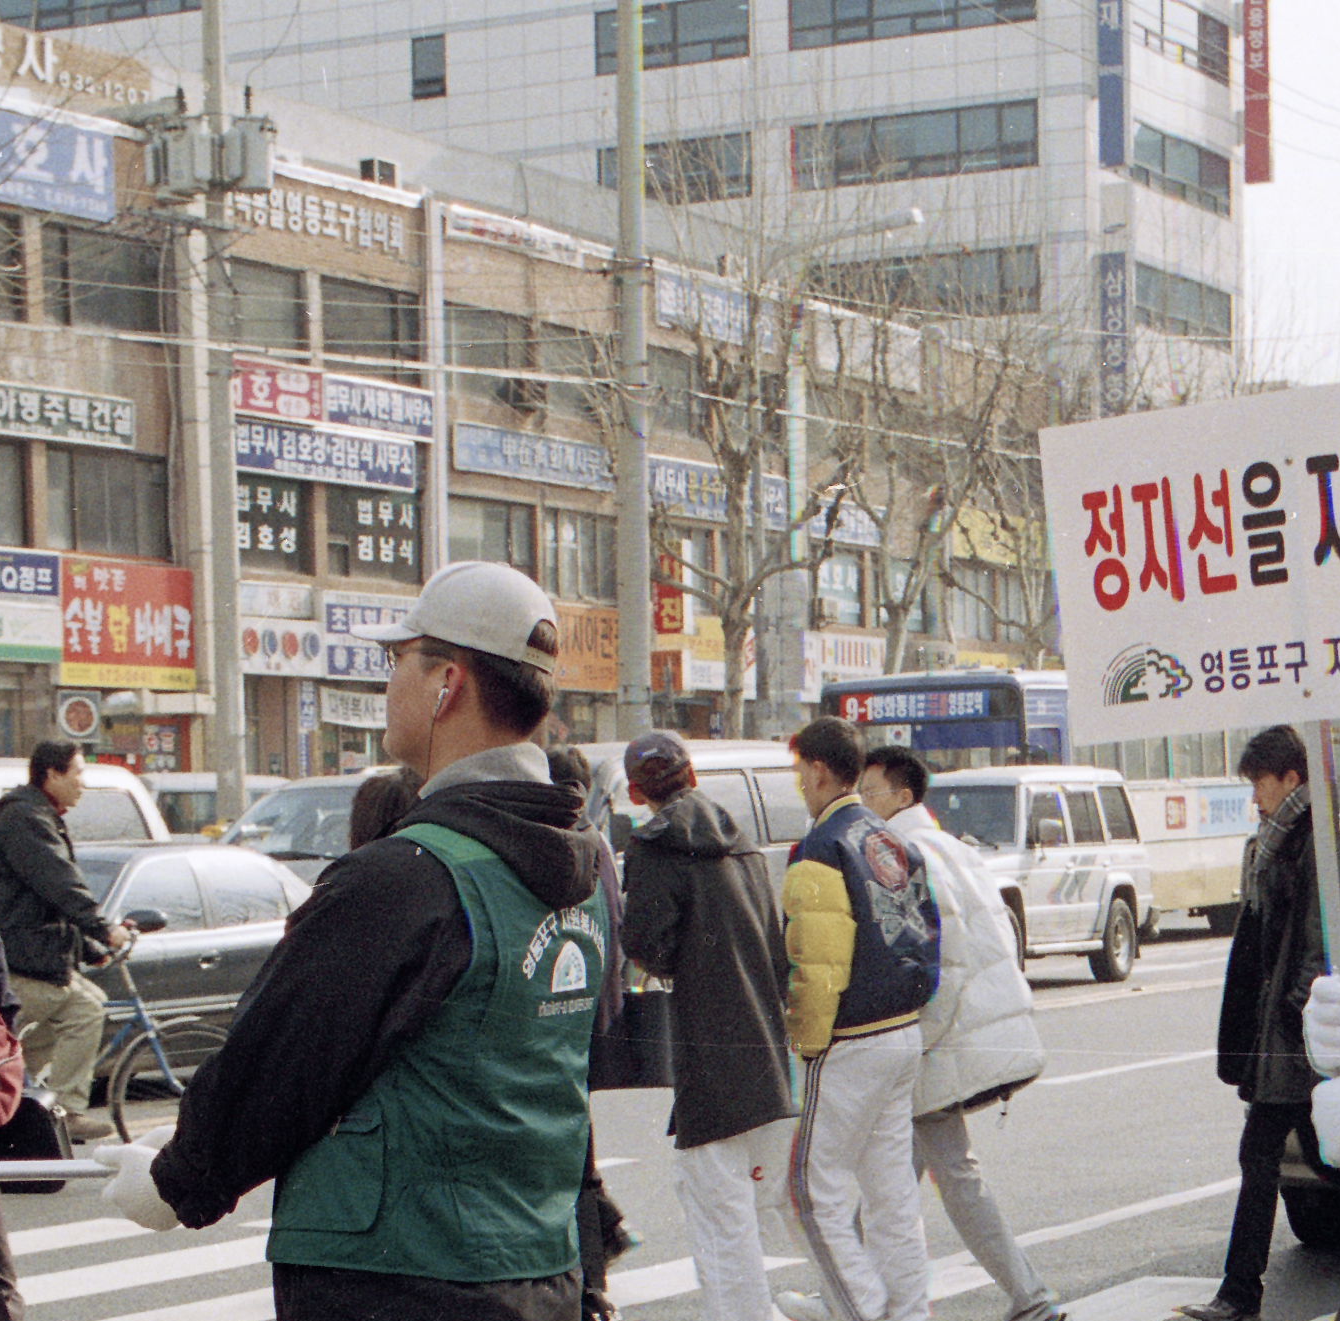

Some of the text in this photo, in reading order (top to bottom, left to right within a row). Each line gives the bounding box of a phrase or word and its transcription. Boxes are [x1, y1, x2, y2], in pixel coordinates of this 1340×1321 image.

[1081, 461, 1290, 613] 정지선을
[1200, 643, 1309, 693] 영등포구
[845, 697, 874, 722] 9-1
